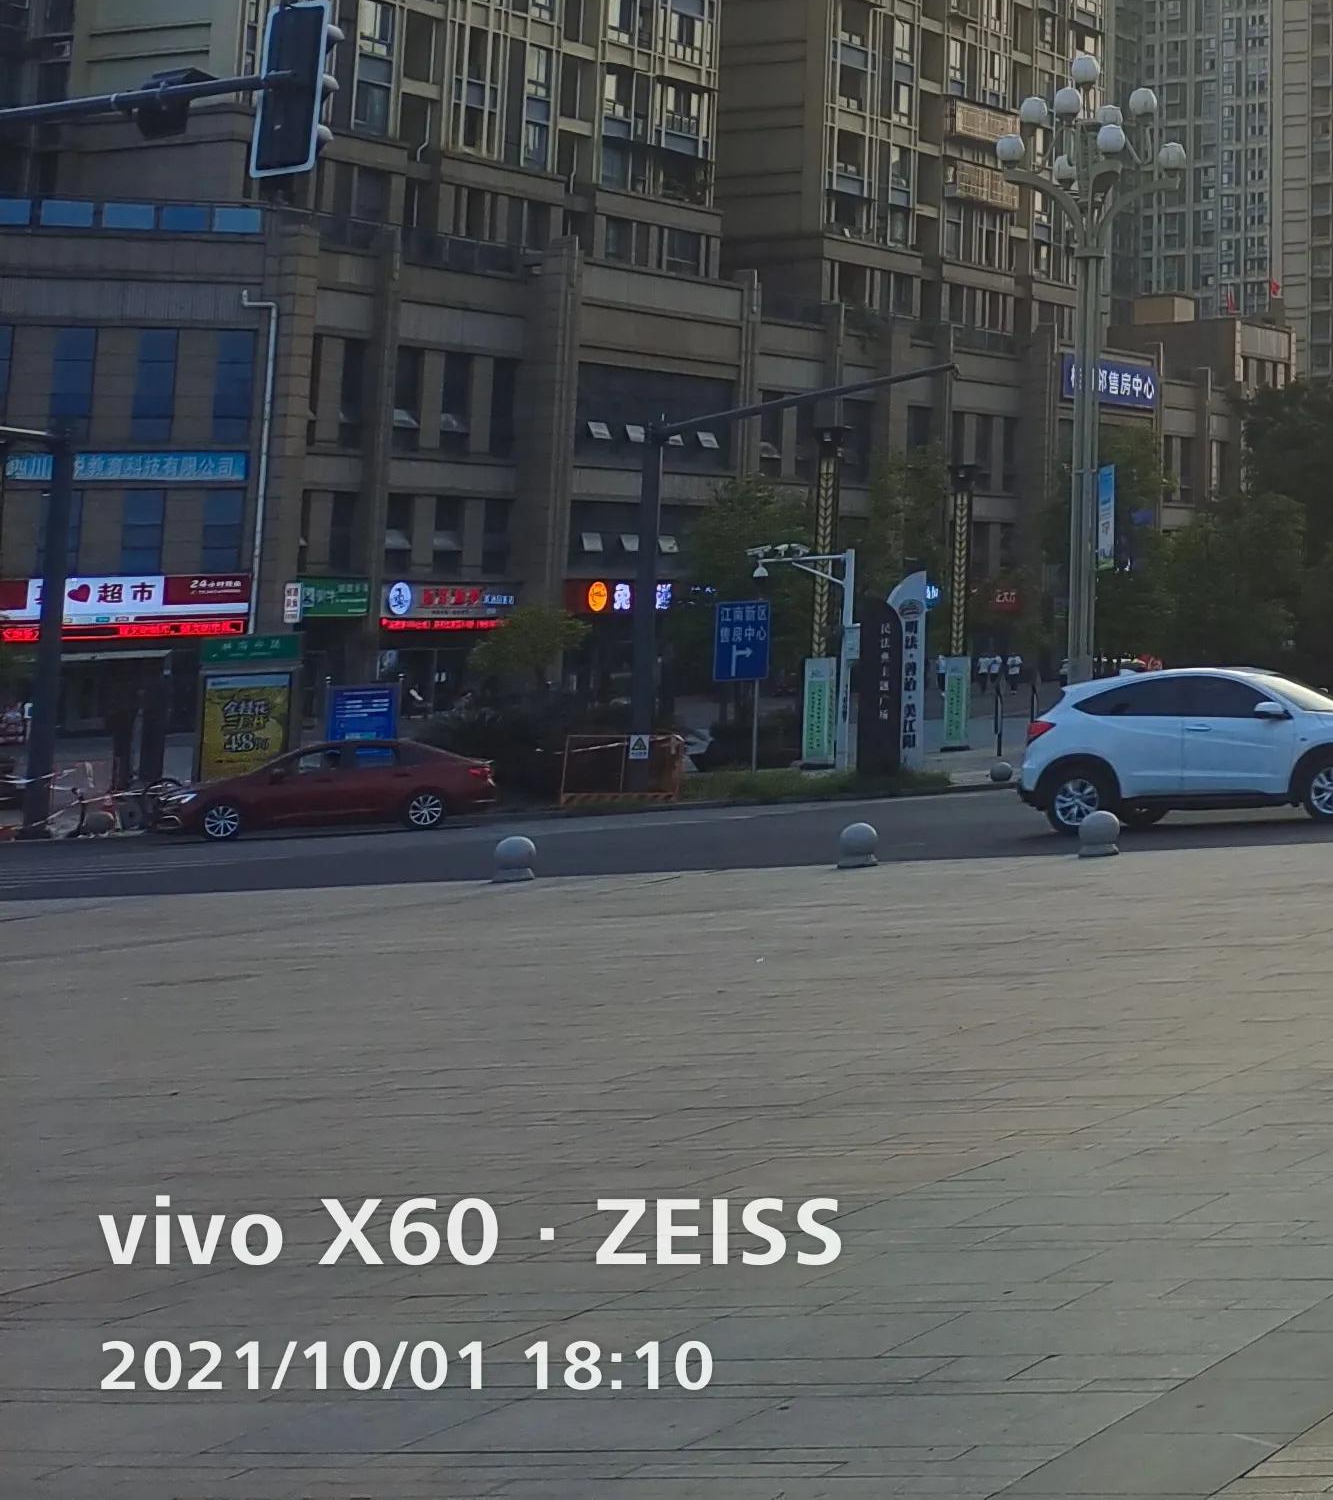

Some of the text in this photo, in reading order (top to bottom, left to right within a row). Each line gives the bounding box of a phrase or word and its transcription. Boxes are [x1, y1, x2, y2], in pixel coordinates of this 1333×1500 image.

[720, 605, 767, 622] 江南新区
[720, 626, 767, 643] 售房中心
